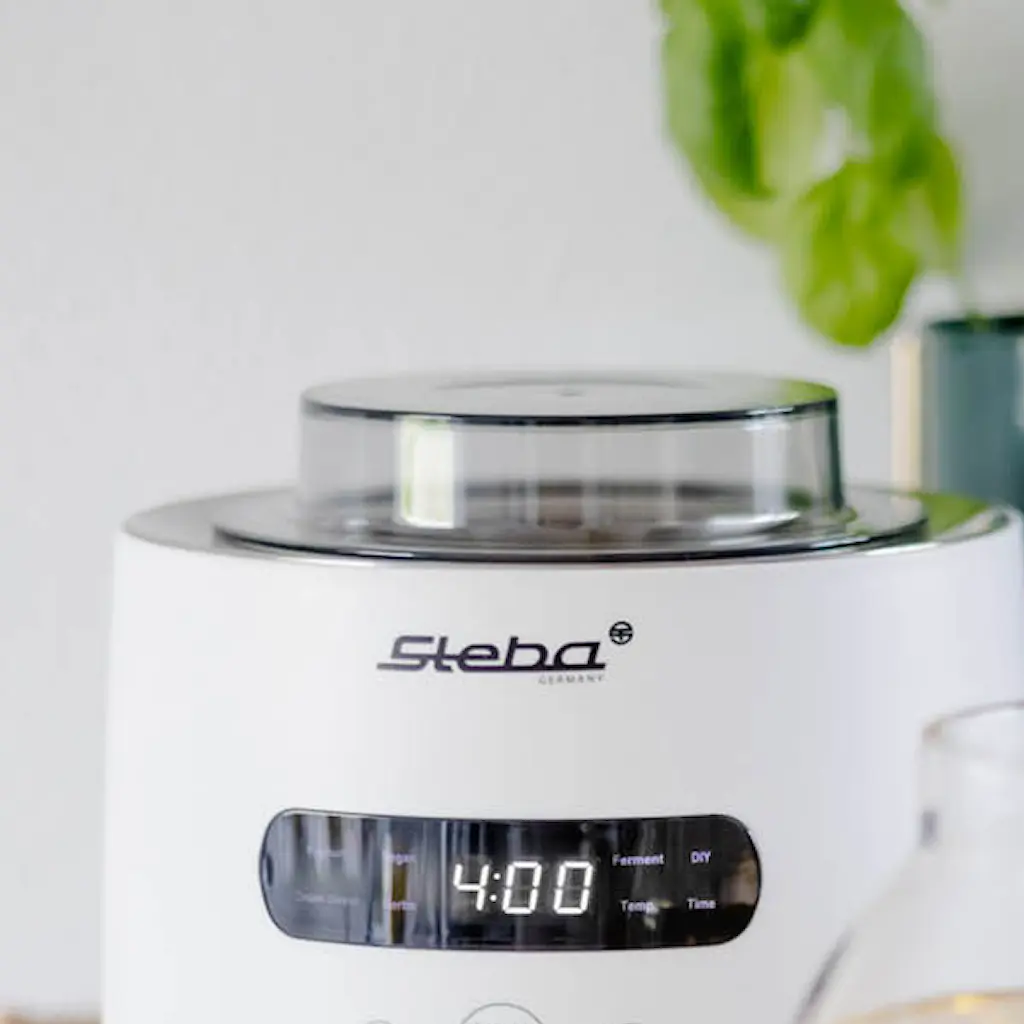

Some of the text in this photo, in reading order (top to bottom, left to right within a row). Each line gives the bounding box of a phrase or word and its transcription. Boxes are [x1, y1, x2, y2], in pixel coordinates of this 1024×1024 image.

[377, 636, 606, 673] Steba
[538, 674, 605, 685] GERMANY
[612, 853, 664, 866] Ferment
[690, 850, 711, 864] DIY
[452, 860, 595, 916] 4:00
[688, 898, 716, 910] Time
